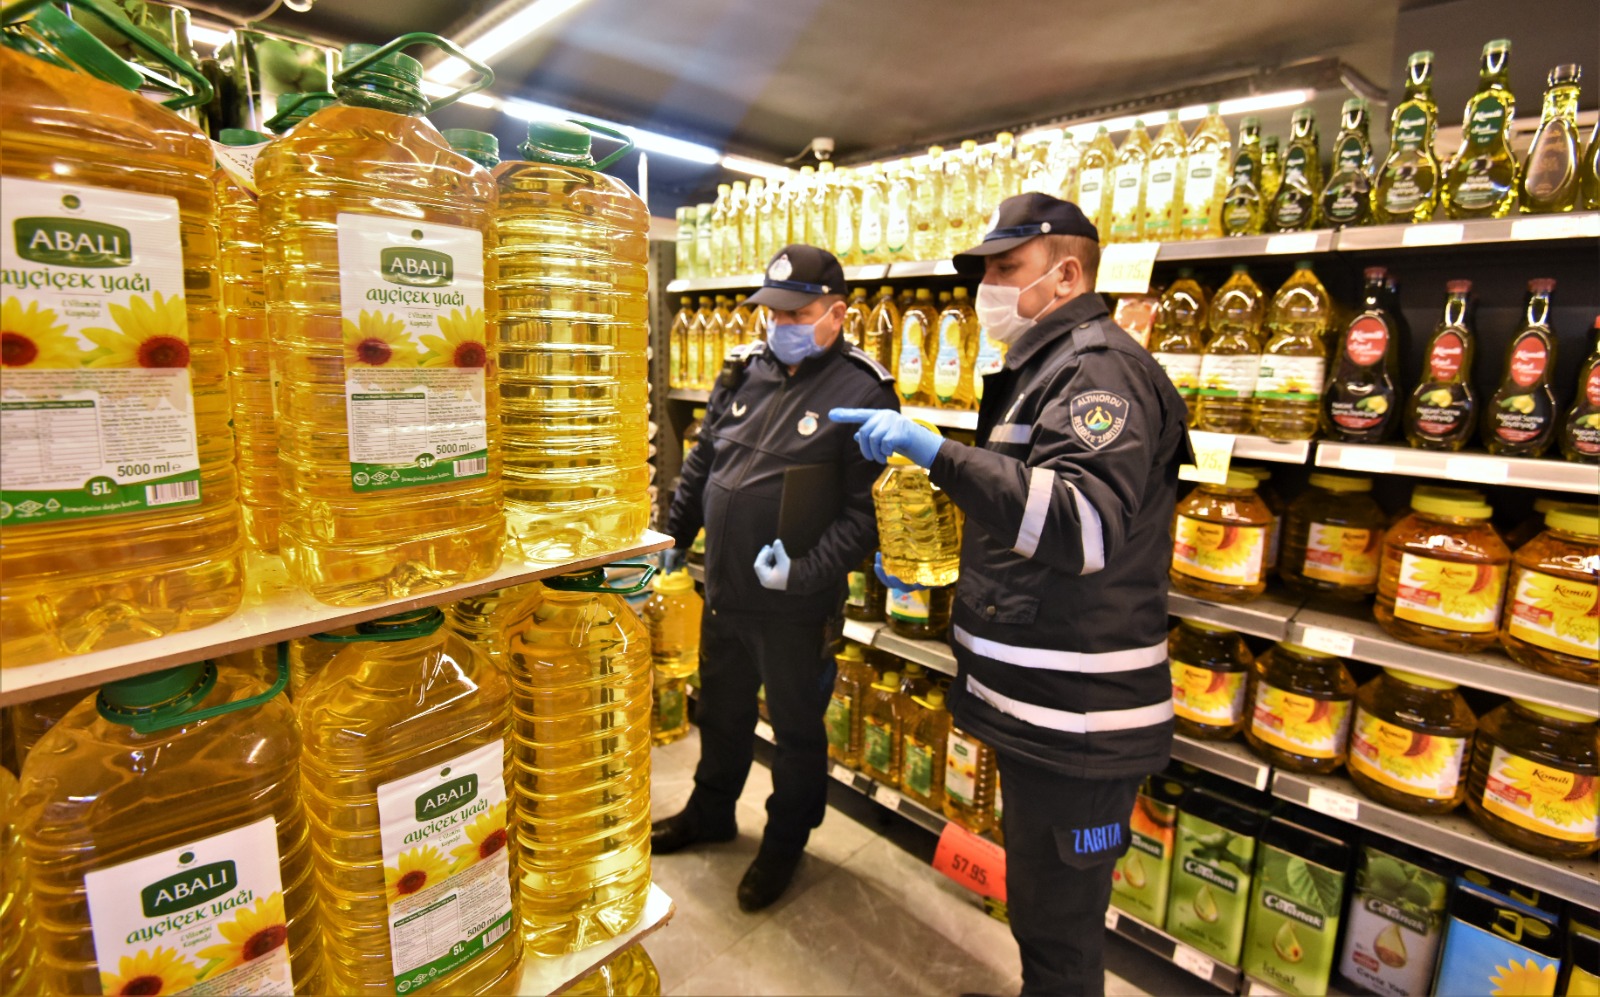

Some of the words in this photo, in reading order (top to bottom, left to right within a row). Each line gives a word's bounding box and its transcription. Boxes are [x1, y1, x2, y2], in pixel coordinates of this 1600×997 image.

[29, 229, 121, 255] ABALI
[389, 257, 447, 277] ABALI
[100, 273, 151, 293] yağı
[366, 287, 430, 305] ayçiçek
[433, 291, 464, 307] yağı
[1077, 394, 1122, 408] ALTINORDU
[436, 444, 458, 455] 5000
[459, 442, 470, 453] ml
[117, 464, 151, 477] 5000
[153, 462, 170, 474] ml
[419, 458, 434, 469] 5L
[91, 482, 112, 496] 5L
[1532, 769, 1569, 785] Komili
[422, 781, 472, 813] ABALI
[403, 813, 458, 845] ayçiçek
[460, 798, 488, 822] yağı
[1071, 822, 1122, 853] ZABITA
[154, 868, 228, 907] ABALI
[126, 908, 208, 945] ayçiçek
[211, 889, 253, 917] yağı
[467, 923, 486, 938] 5000
[486, 914, 497, 927] ml
[453, 943, 465, 956] 5L
